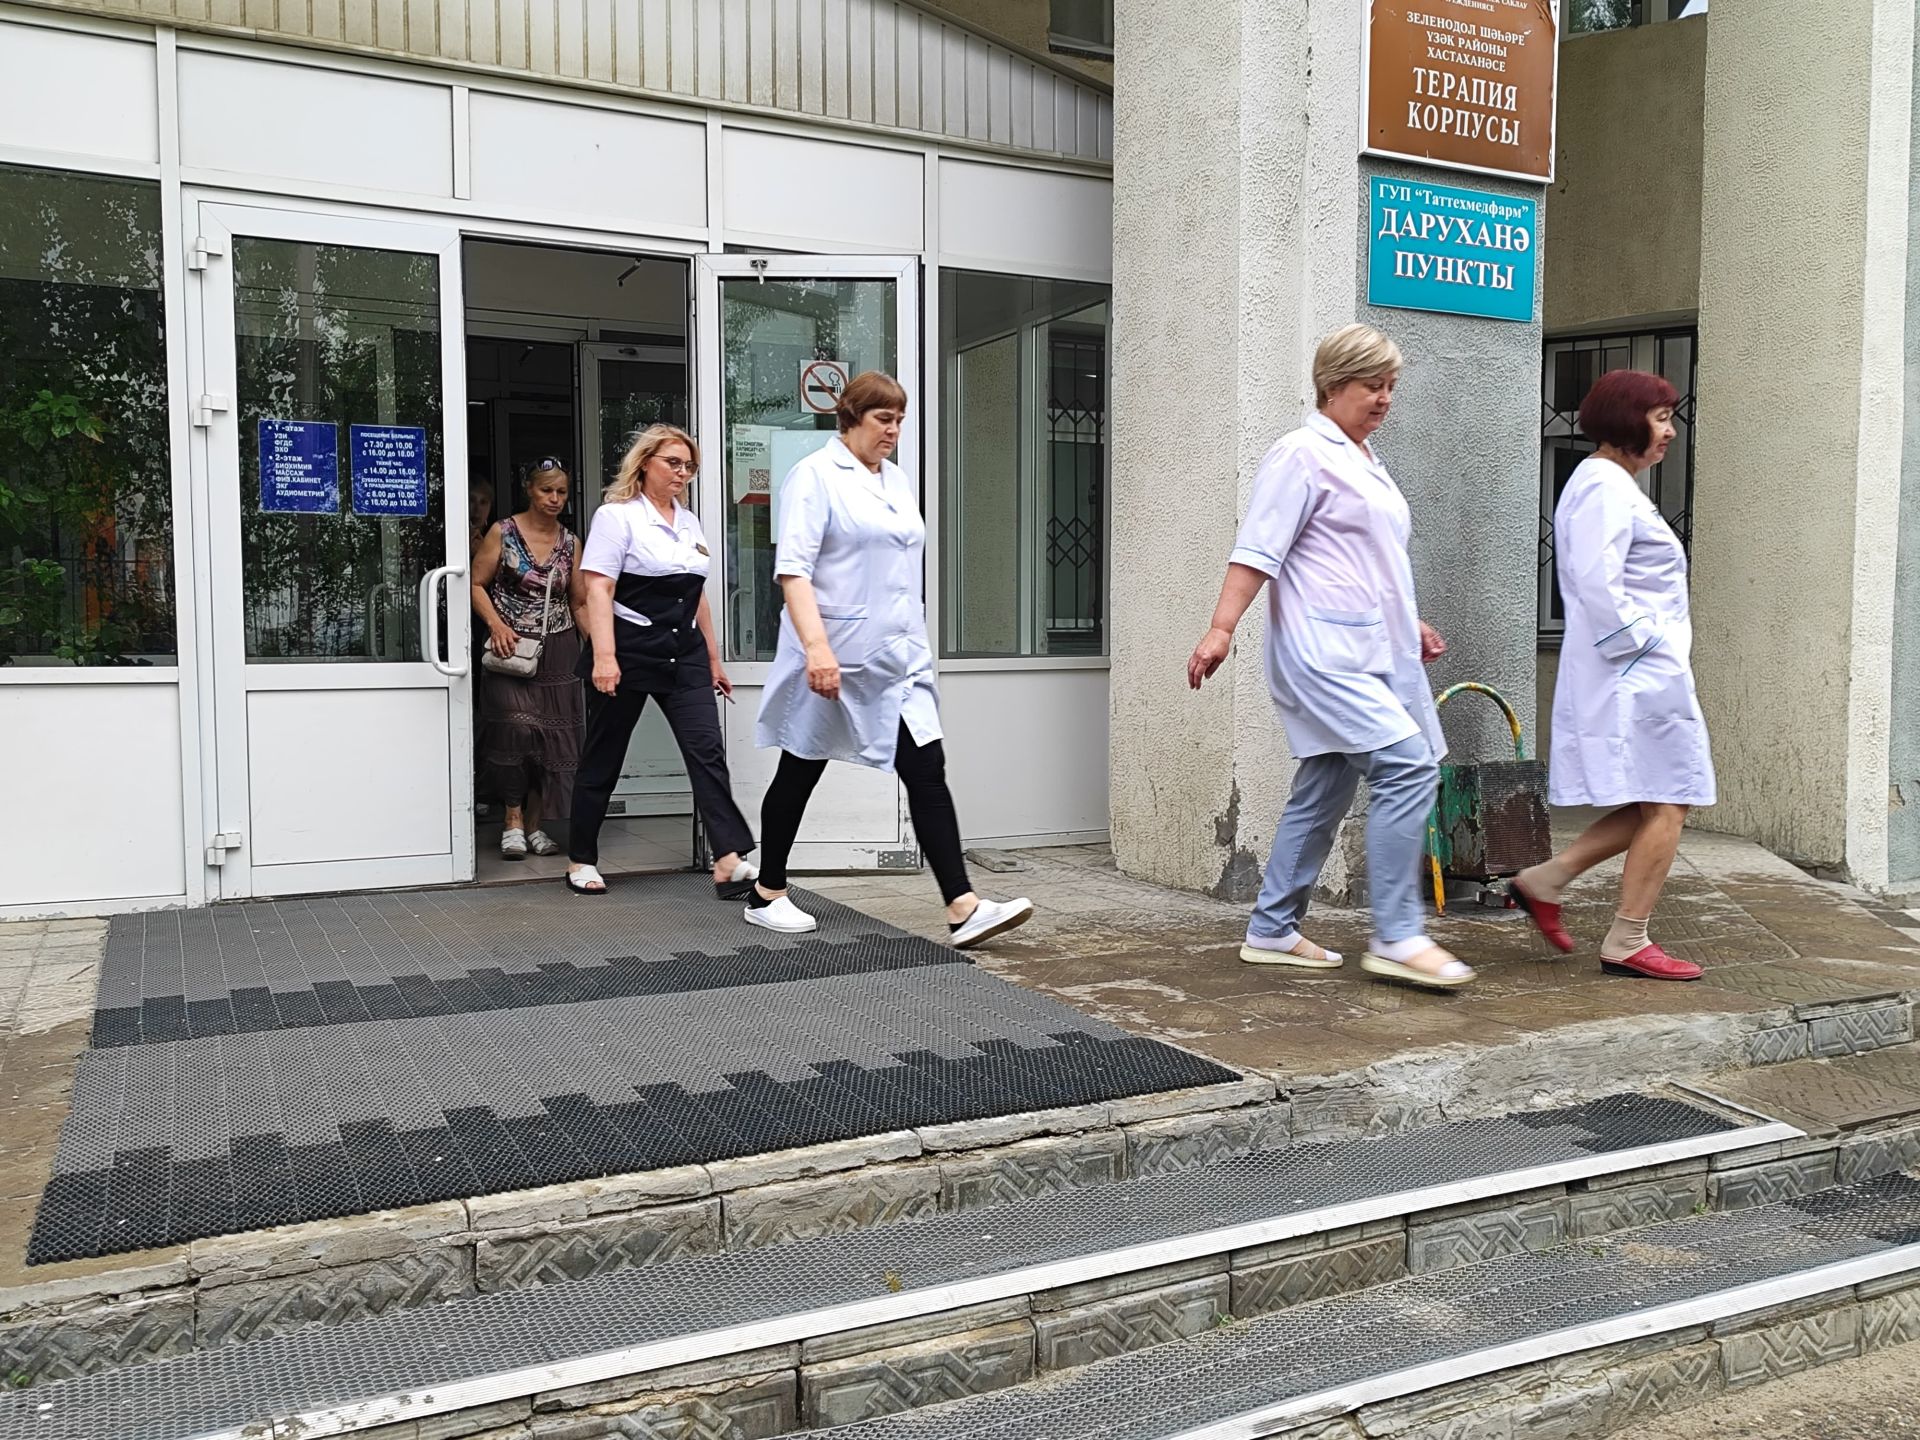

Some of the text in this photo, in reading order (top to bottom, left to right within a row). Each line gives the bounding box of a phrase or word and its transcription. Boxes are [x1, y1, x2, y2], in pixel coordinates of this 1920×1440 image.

[1406, 11, 1476, 36] ЗЕЛЕНОДОЛ
[1458, 34, 1507, 58] РАЙОНЫ
[1427, 47, 1506, 72] ХАСТАХАНӘСЕ
[1412, 67, 1518, 112] ТЕРАПИЯ
[1407, 101, 1521, 146] КОРПУСЫ
[1379, 183, 1411, 202] ГУП
[1378, 207, 1530, 252] ДАРУХАНӘ
[1394, 250, 1515, 290] ПУНКТЫ
[275, 453, 303, 462] 2-этаж
[275, 462, 312, 470] БИОХИМИЯ
